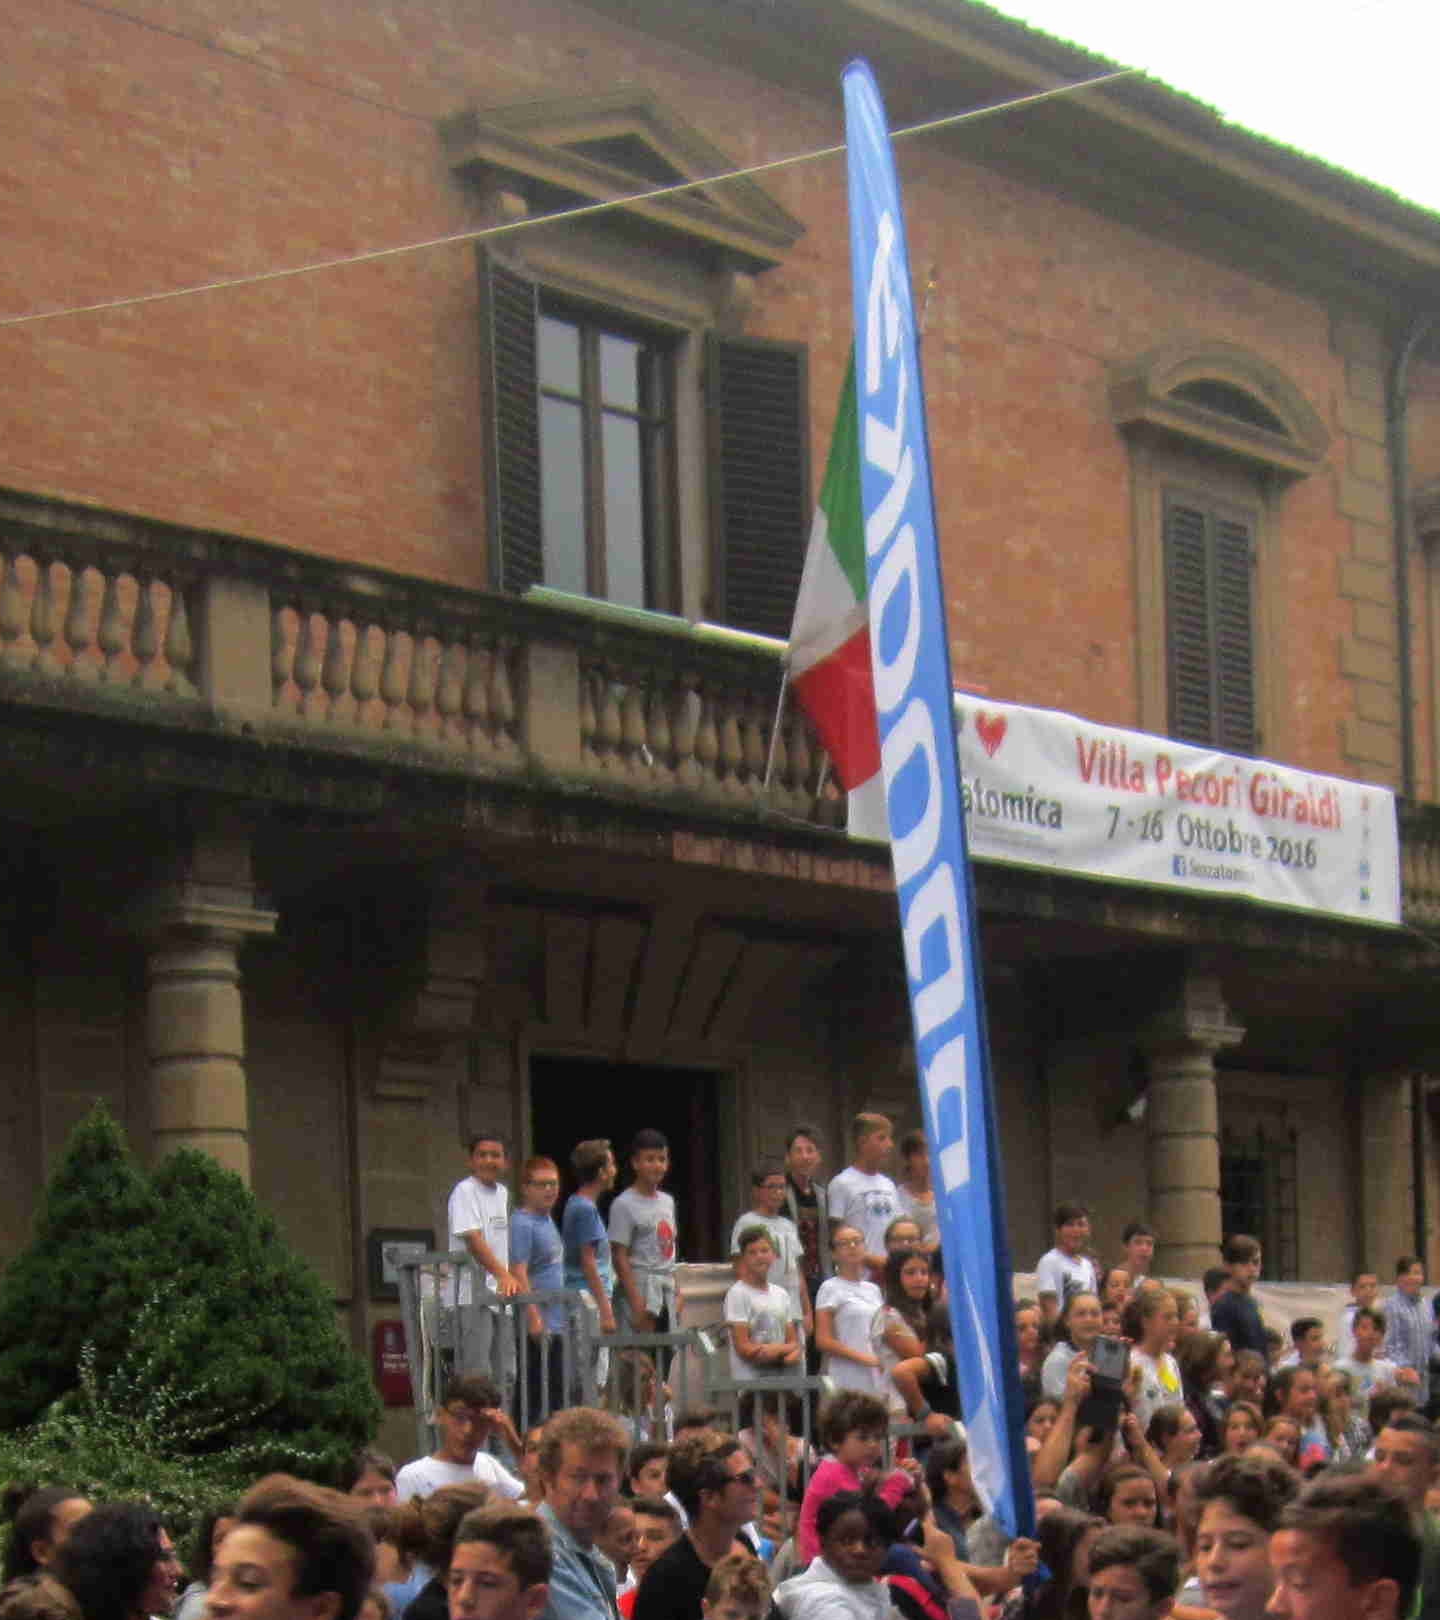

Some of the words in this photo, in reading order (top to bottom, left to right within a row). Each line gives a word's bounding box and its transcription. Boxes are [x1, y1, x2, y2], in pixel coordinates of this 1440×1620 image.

[1075, 737, 1146, 794] Villa
[1155, 754, 1241, 808] Pecori
[1249, 772, 1344, 831] Giraldi
[1107, 805, 1121, 840] 7
[1140, 810, 1165, 842] 16
[1177, 813, 1262, 859] Ottobre
[1266, 835, 1317, 869] 2016
